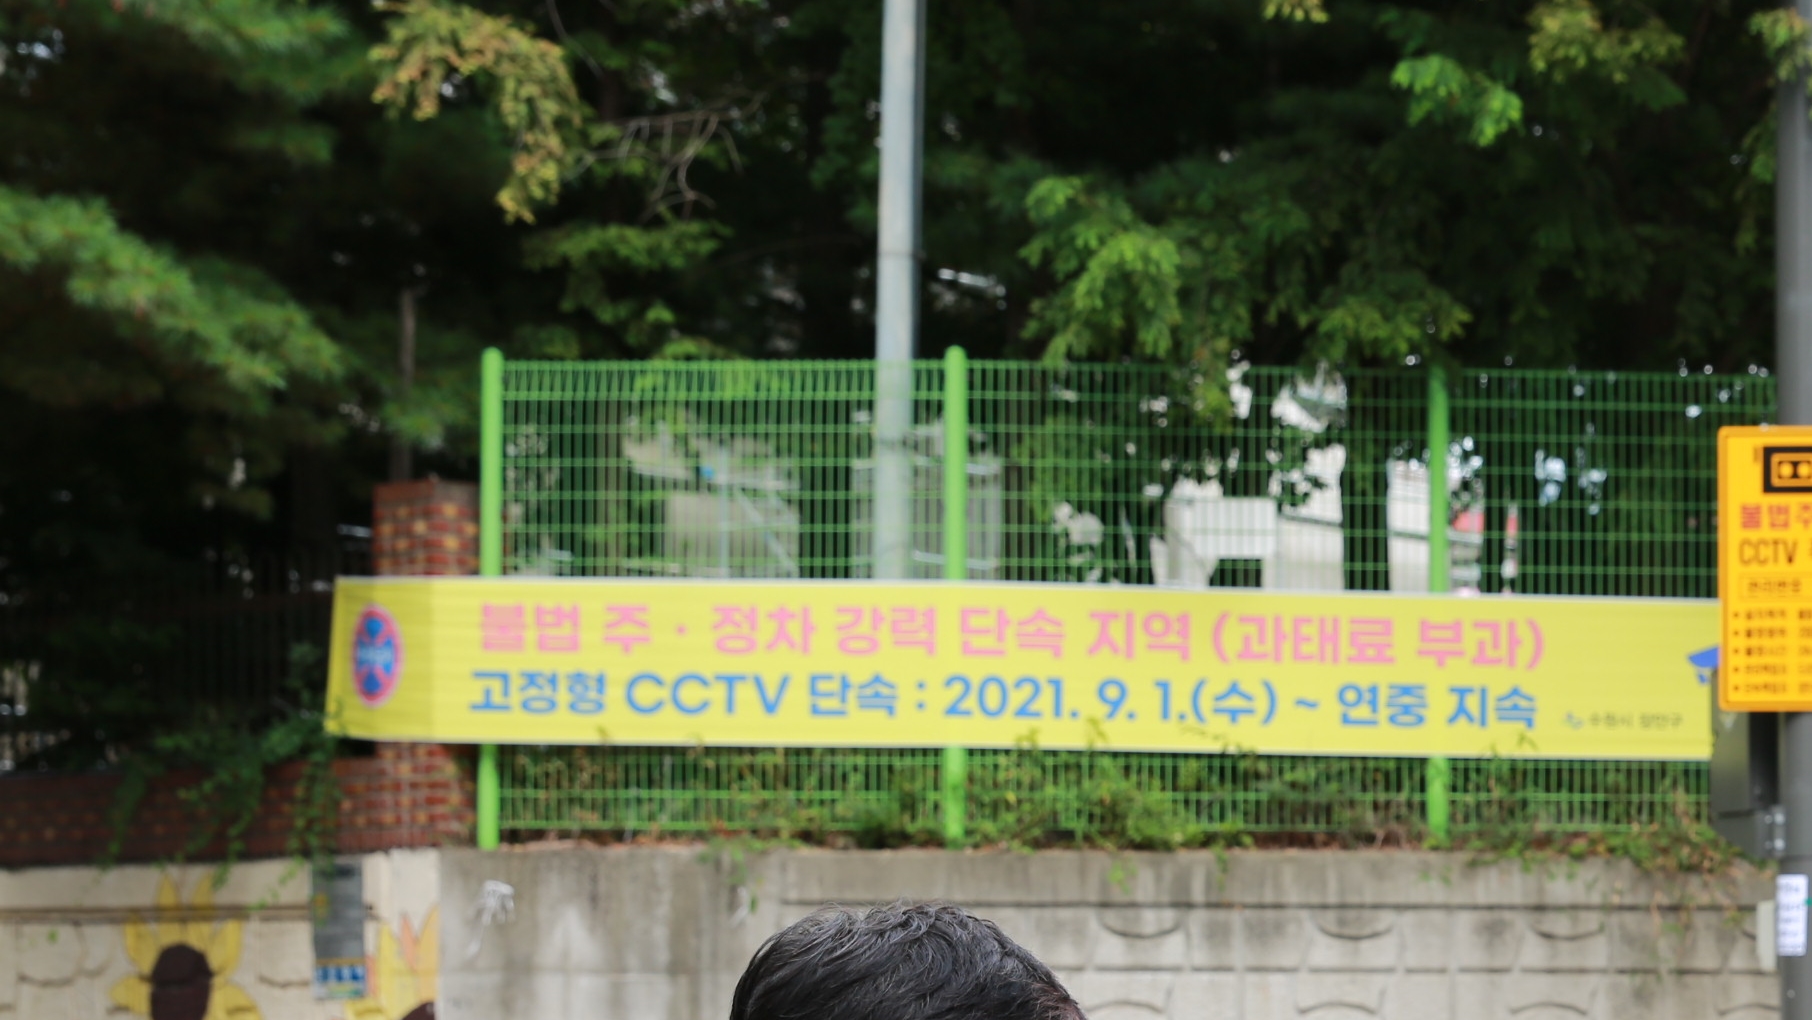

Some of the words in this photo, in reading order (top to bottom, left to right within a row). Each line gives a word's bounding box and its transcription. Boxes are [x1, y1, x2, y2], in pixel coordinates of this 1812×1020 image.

[1738, 537, 1798, 567] CCTV
[480, 602, 582, 654] 불법
[712, 604, 817, 656] 정차
[836, 605, 938, 657] 강력
[959, 606, 1066, 659] 단속
[1086, 610, 1192, 662] 지역
[1211, 612, 1397, 666] (과태료
[1416, 618, 1545, 671] 부과)
[471, 670, 607, 714] 고정형
[625, 672, 790, 715] CCTV
[809, 673, 898, 716] 단속
[944, 674, 1079, 719] 2021.
[1337, 683, 1427, 728] 연중
[1447, 686, 1536, 729] 지속
